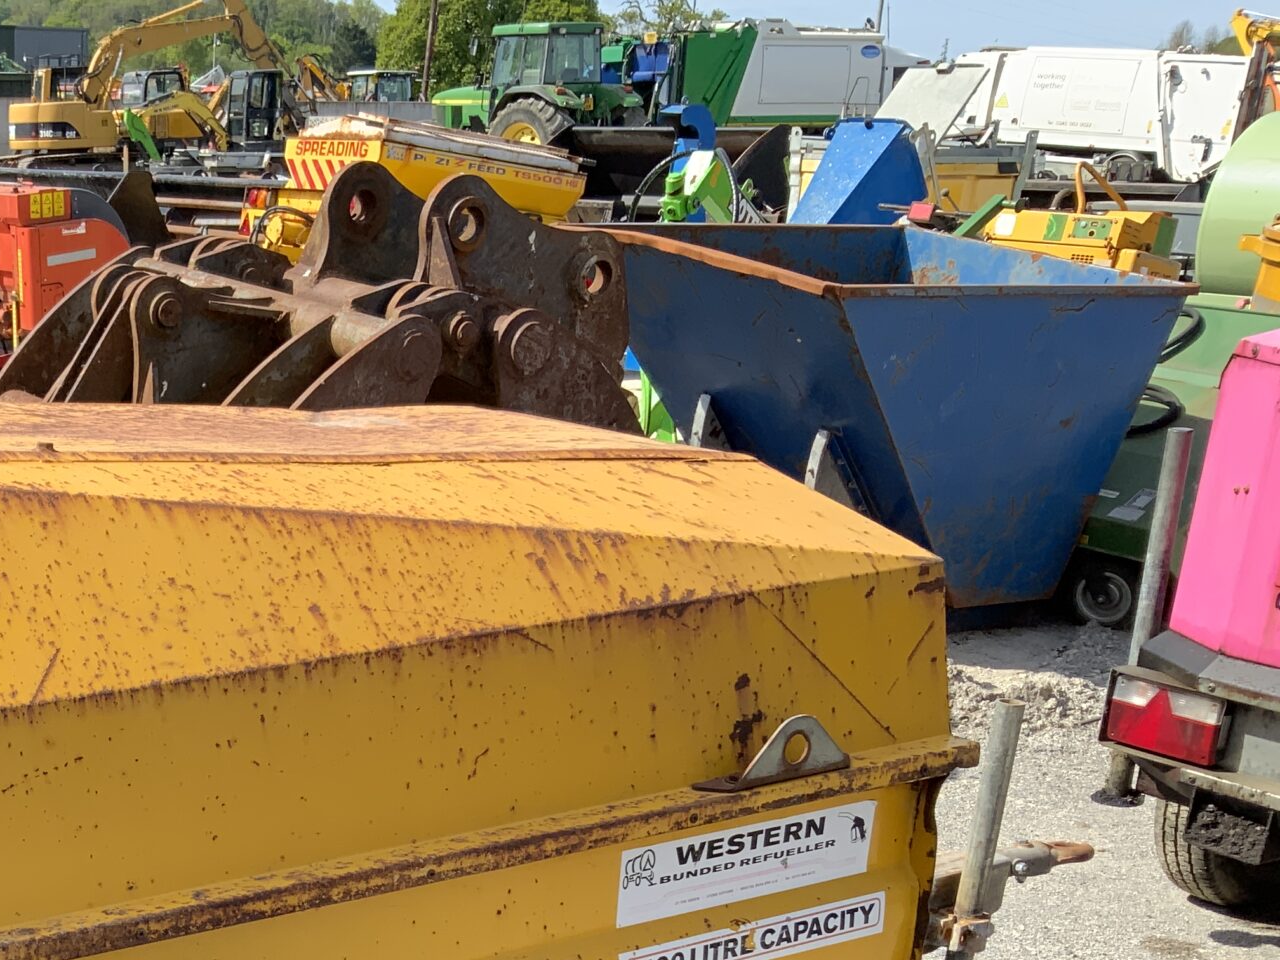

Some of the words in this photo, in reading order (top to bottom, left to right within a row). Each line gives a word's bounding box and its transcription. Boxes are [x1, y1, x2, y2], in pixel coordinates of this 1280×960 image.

[1032, 81, 1064, 91] together
[1036, 73, 1066, 82] working
[295, 140, 370, 158] SPREADING
[468, 163, 506, 176] FEED
[512, 169, 563, 185] TS500
[676, 816, 826, 866] WESTERN
[658, 861, 736, 885] BUNDED
[739, 839, 836, 868] REFUELLER
[759, 902, 876, 950] CAPACITY
